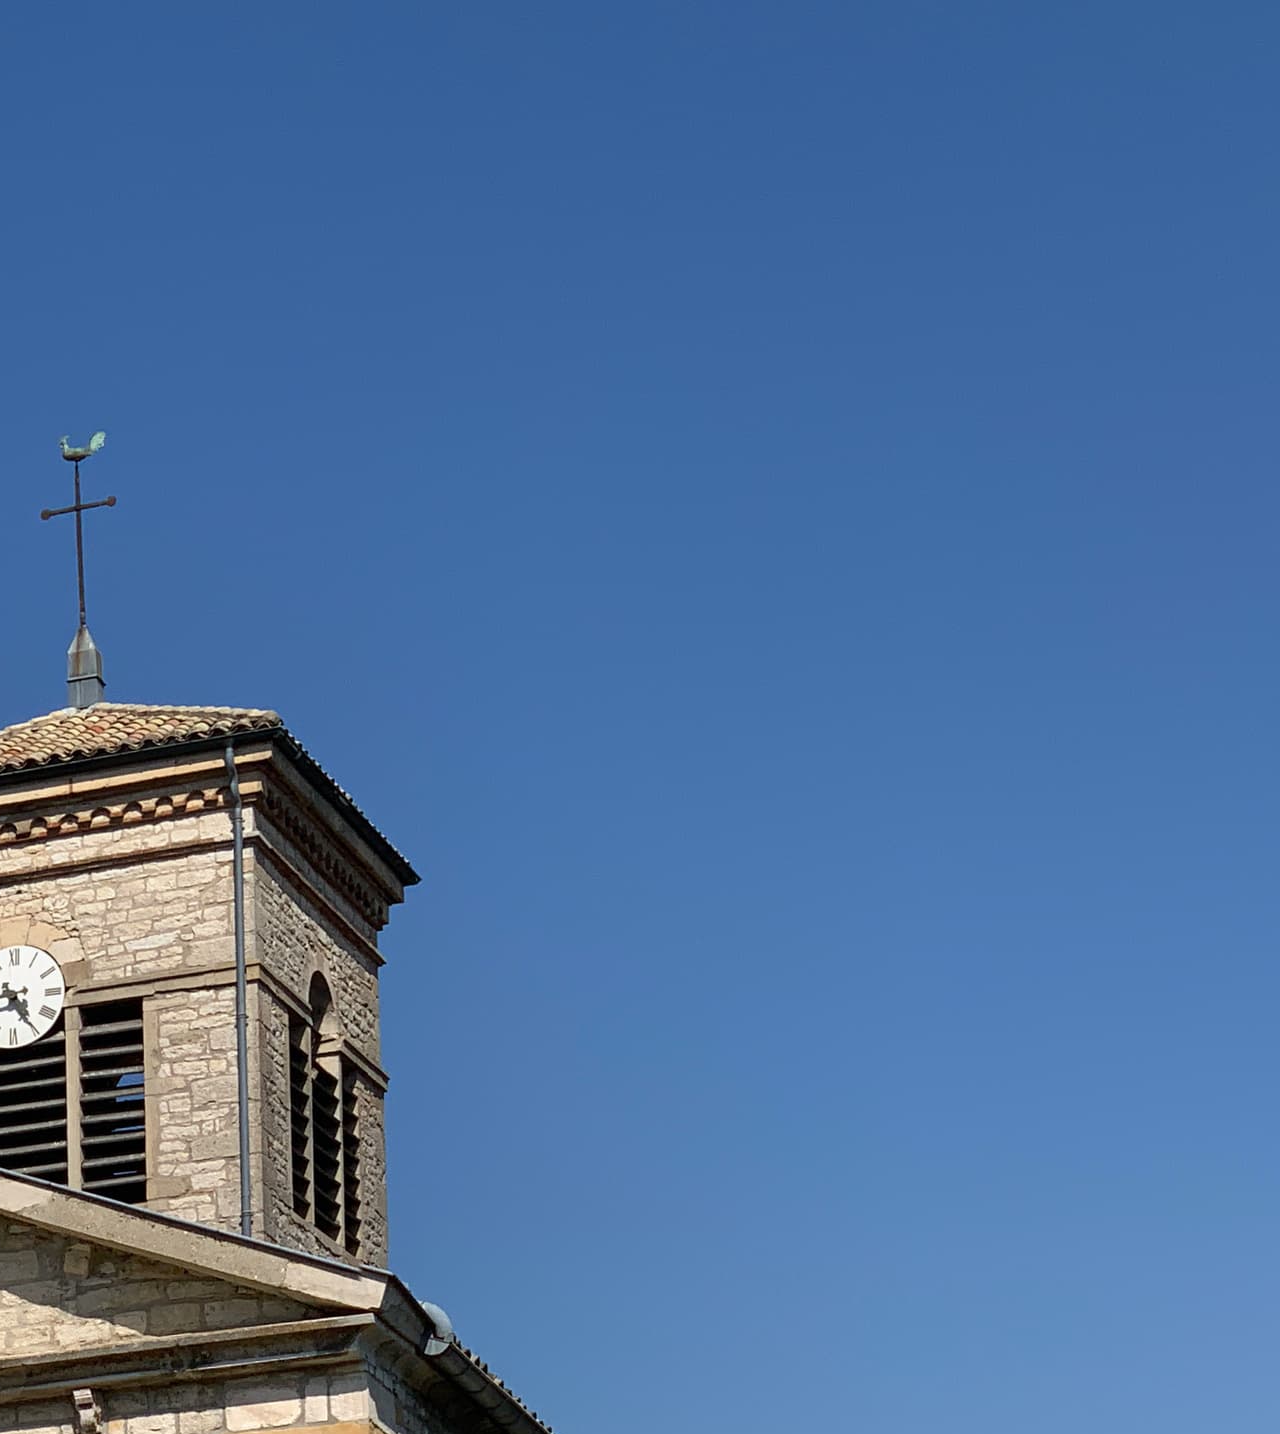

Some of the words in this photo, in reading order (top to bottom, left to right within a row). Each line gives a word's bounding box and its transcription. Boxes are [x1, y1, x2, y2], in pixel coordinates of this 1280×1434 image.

[9, 948, 20, 966] XII
[39, 966, 56, 979] II
[44, 987, 62, 996] III
[38, 1005, 57, 1021] IIII
[9, 1028, 18, 1045] VI
